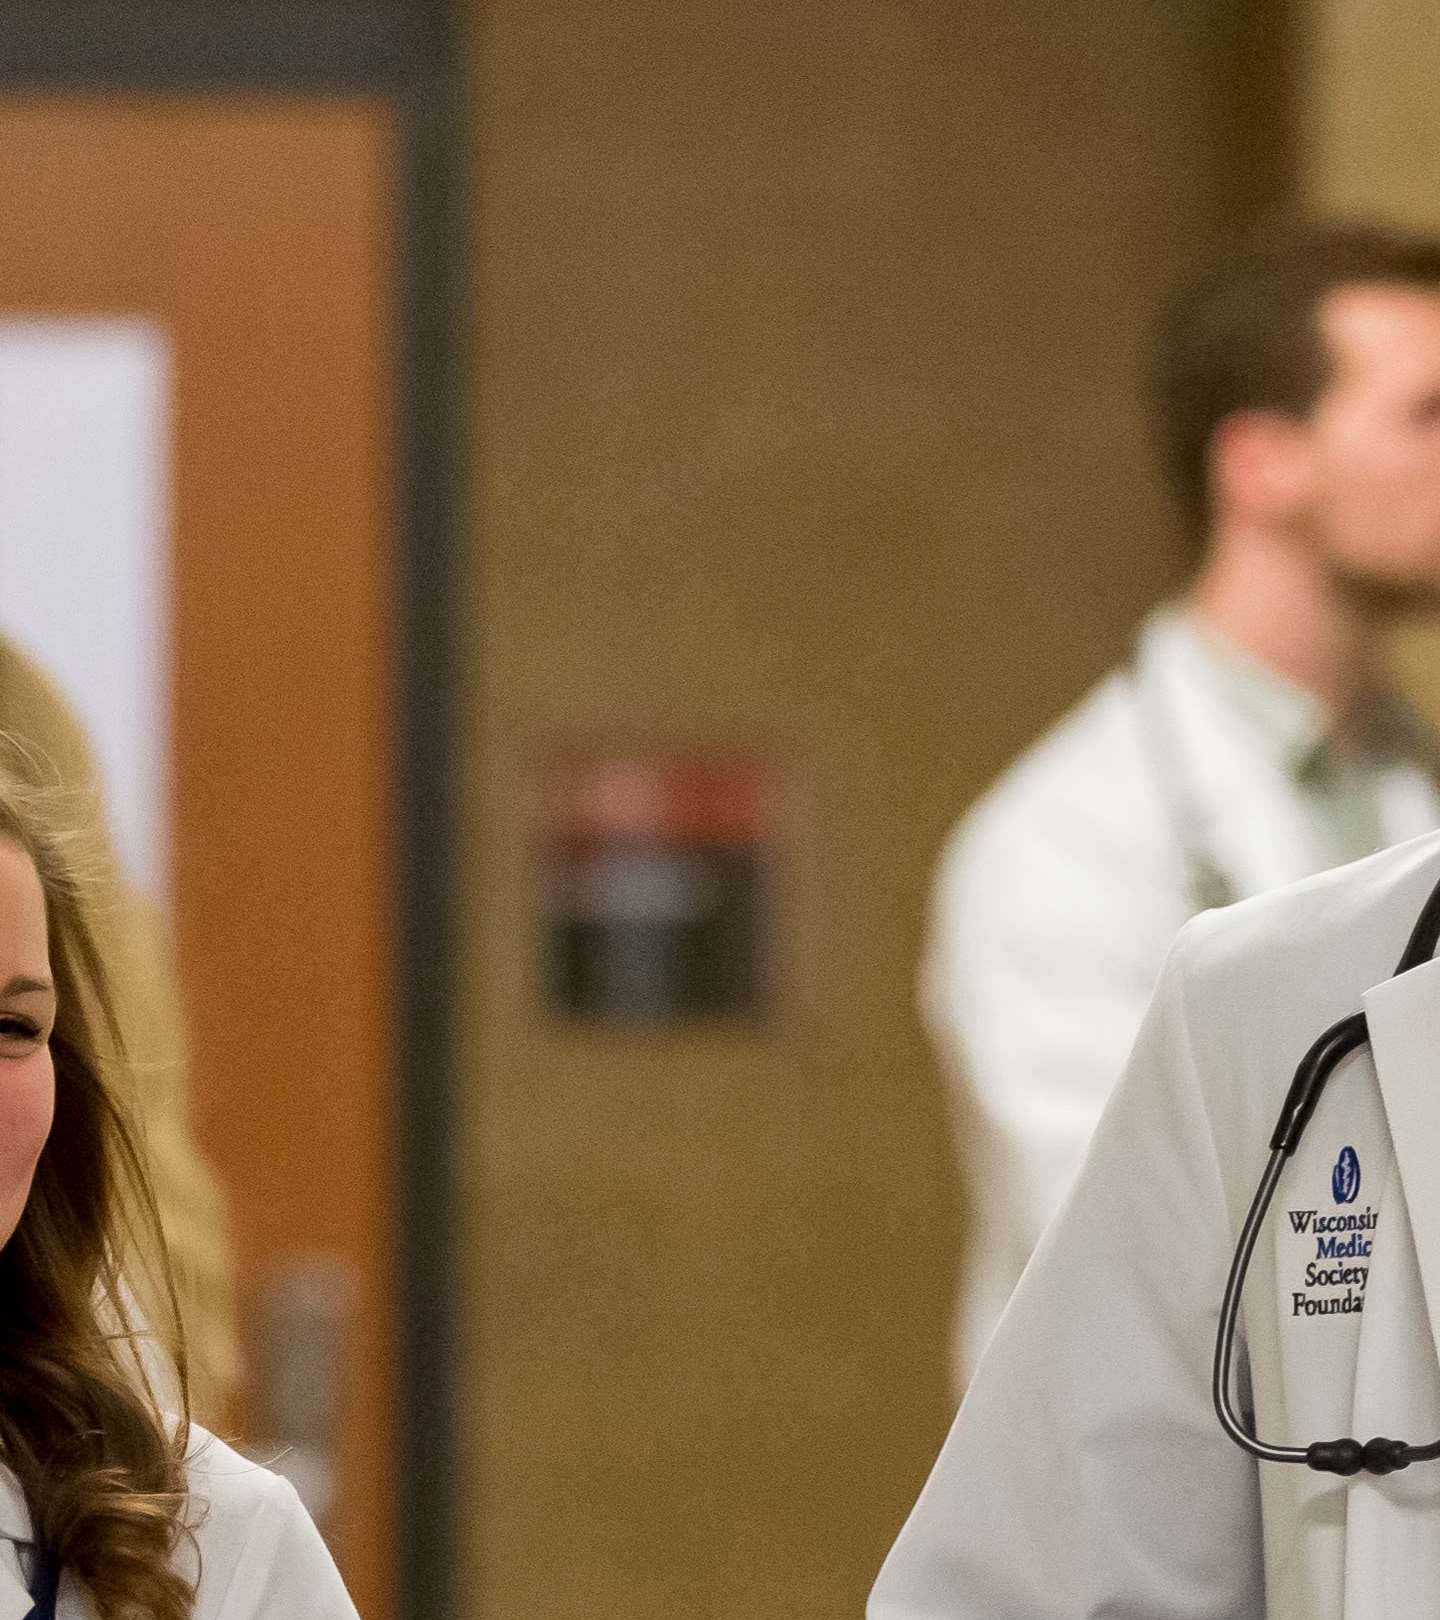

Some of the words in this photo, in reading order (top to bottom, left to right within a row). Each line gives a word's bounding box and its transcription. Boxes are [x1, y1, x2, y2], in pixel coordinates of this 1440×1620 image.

[1316, 1233, 1373, 1259] Medic
[1305, 1261, 1369, 1291] Society
[1292, 1287, 1365, 1316] Founda
